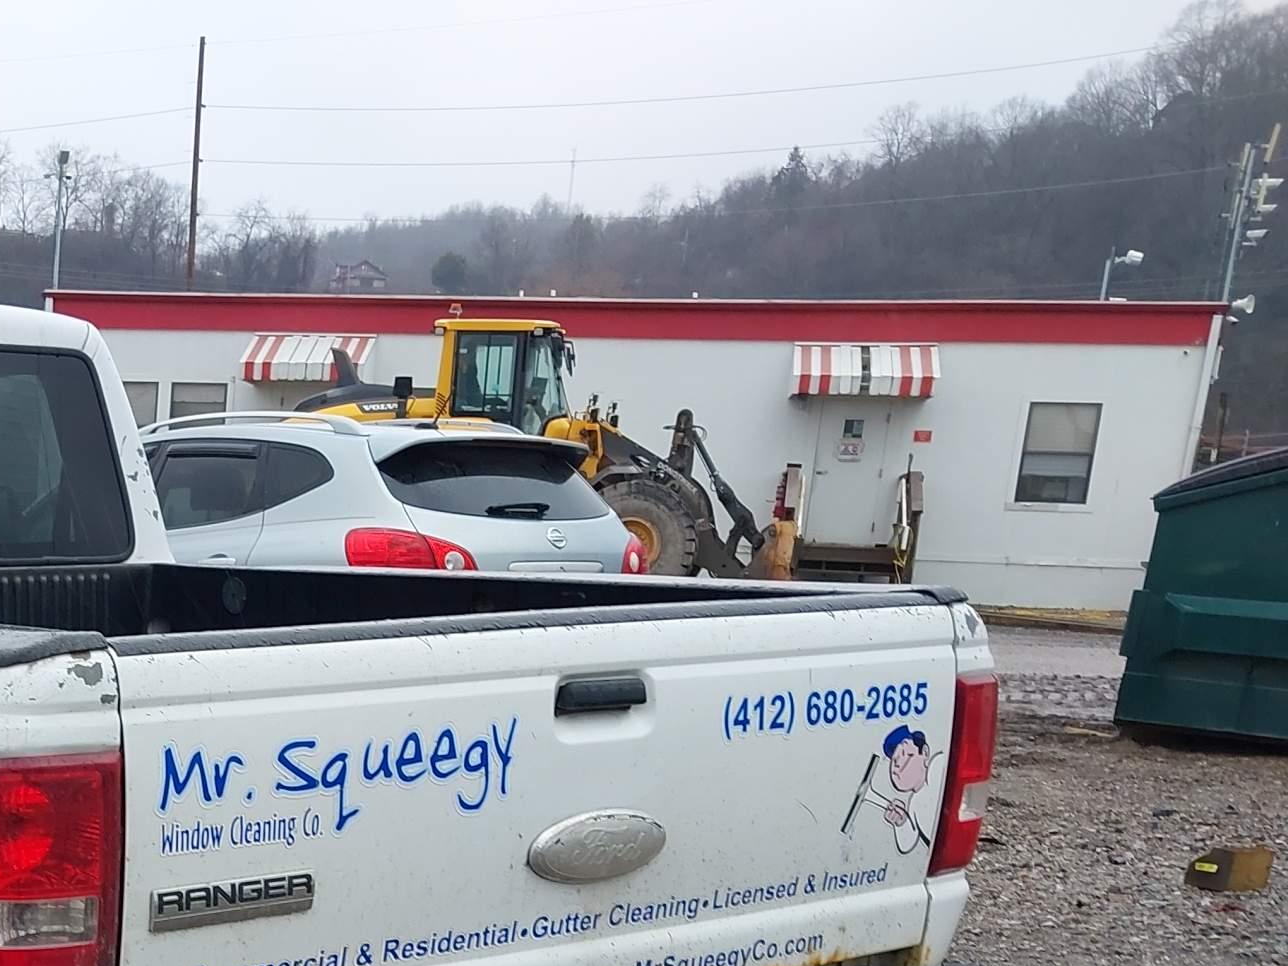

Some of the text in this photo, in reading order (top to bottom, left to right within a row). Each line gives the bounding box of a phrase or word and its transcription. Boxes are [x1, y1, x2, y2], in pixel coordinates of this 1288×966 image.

[724, 682, 929, 740] (412) 680-2685
[160, 717, 517, 832] Mr. Squeegy
[161, 809, 324, 855] Window Cleaning Co.
[157, 873, 313, 915] RANGER
[356, 944, 374, 966] &
[803, 874, 817, 893] &
[822, 863, 888, 891] Insured
